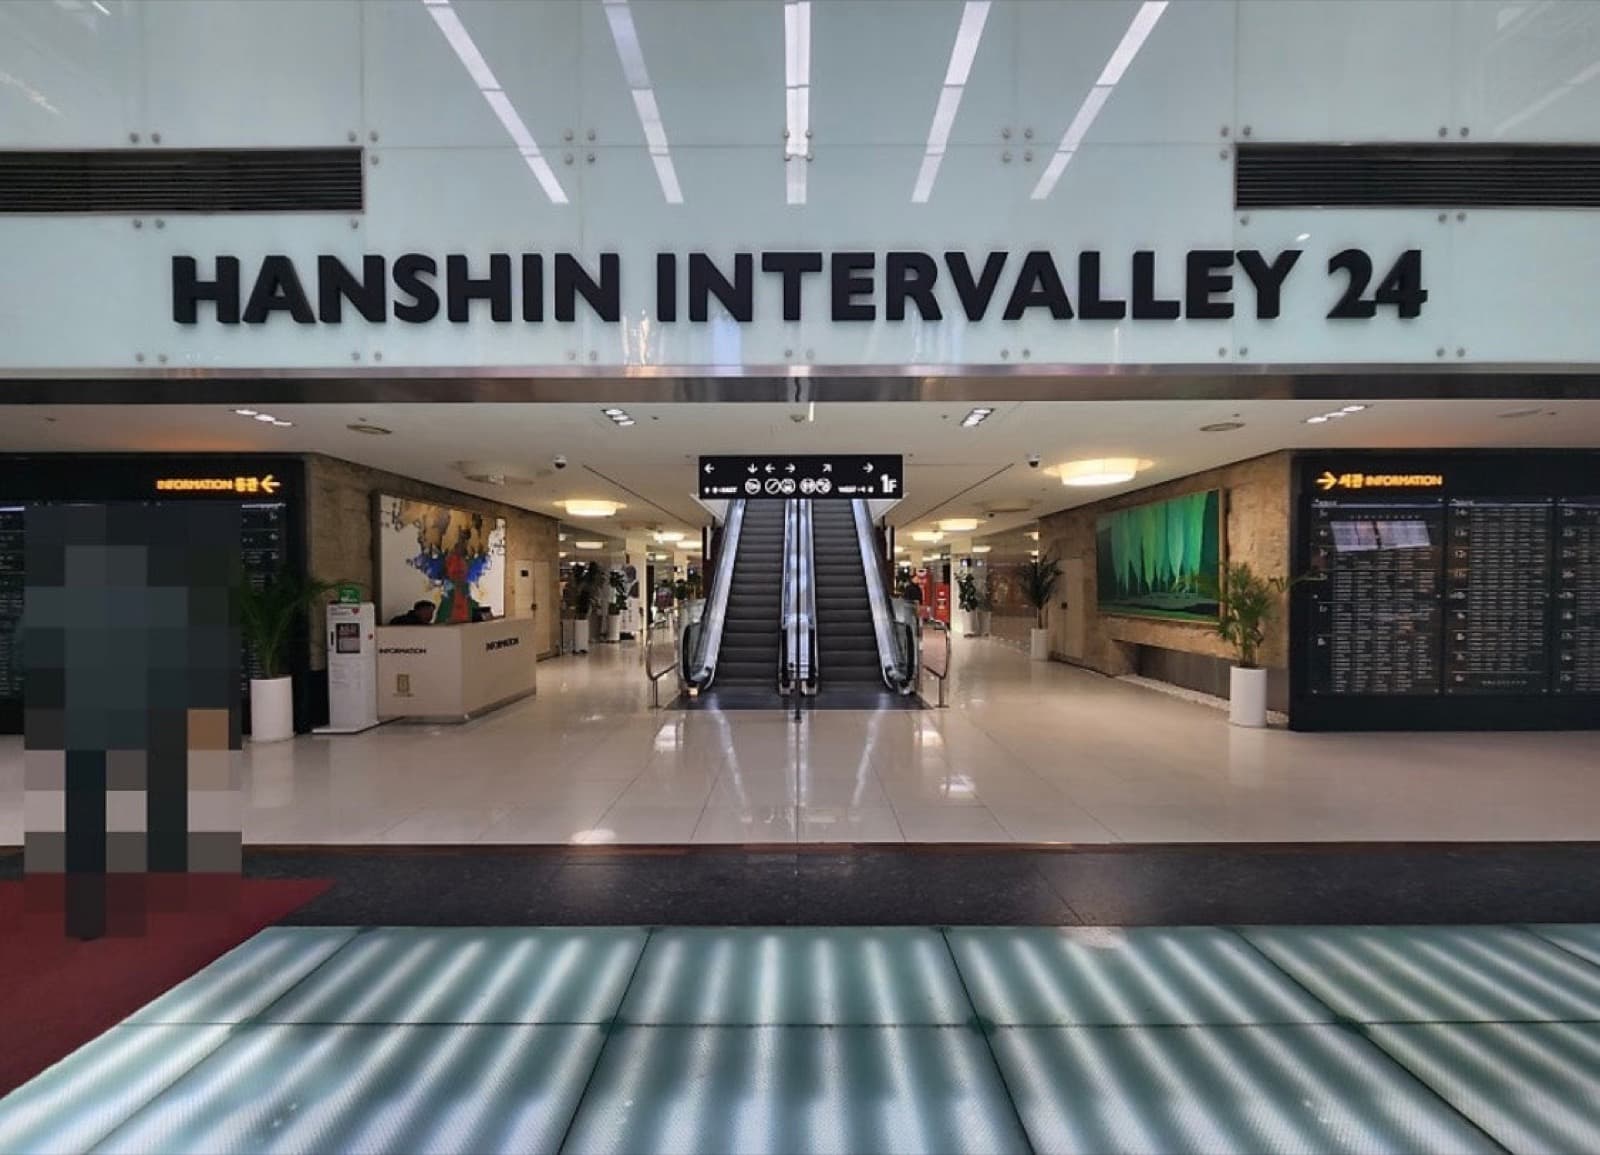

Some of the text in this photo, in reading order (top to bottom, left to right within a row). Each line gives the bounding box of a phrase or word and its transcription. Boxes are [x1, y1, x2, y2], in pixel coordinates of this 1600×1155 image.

[172, 248, 1428, 325] HANSHIN INTERVALLEY 24
[156, 479, 233, 490] INFORMATION
[880, 474, 897, 493] 1F
[1365, 475, 1443, 487] INFORMATION
